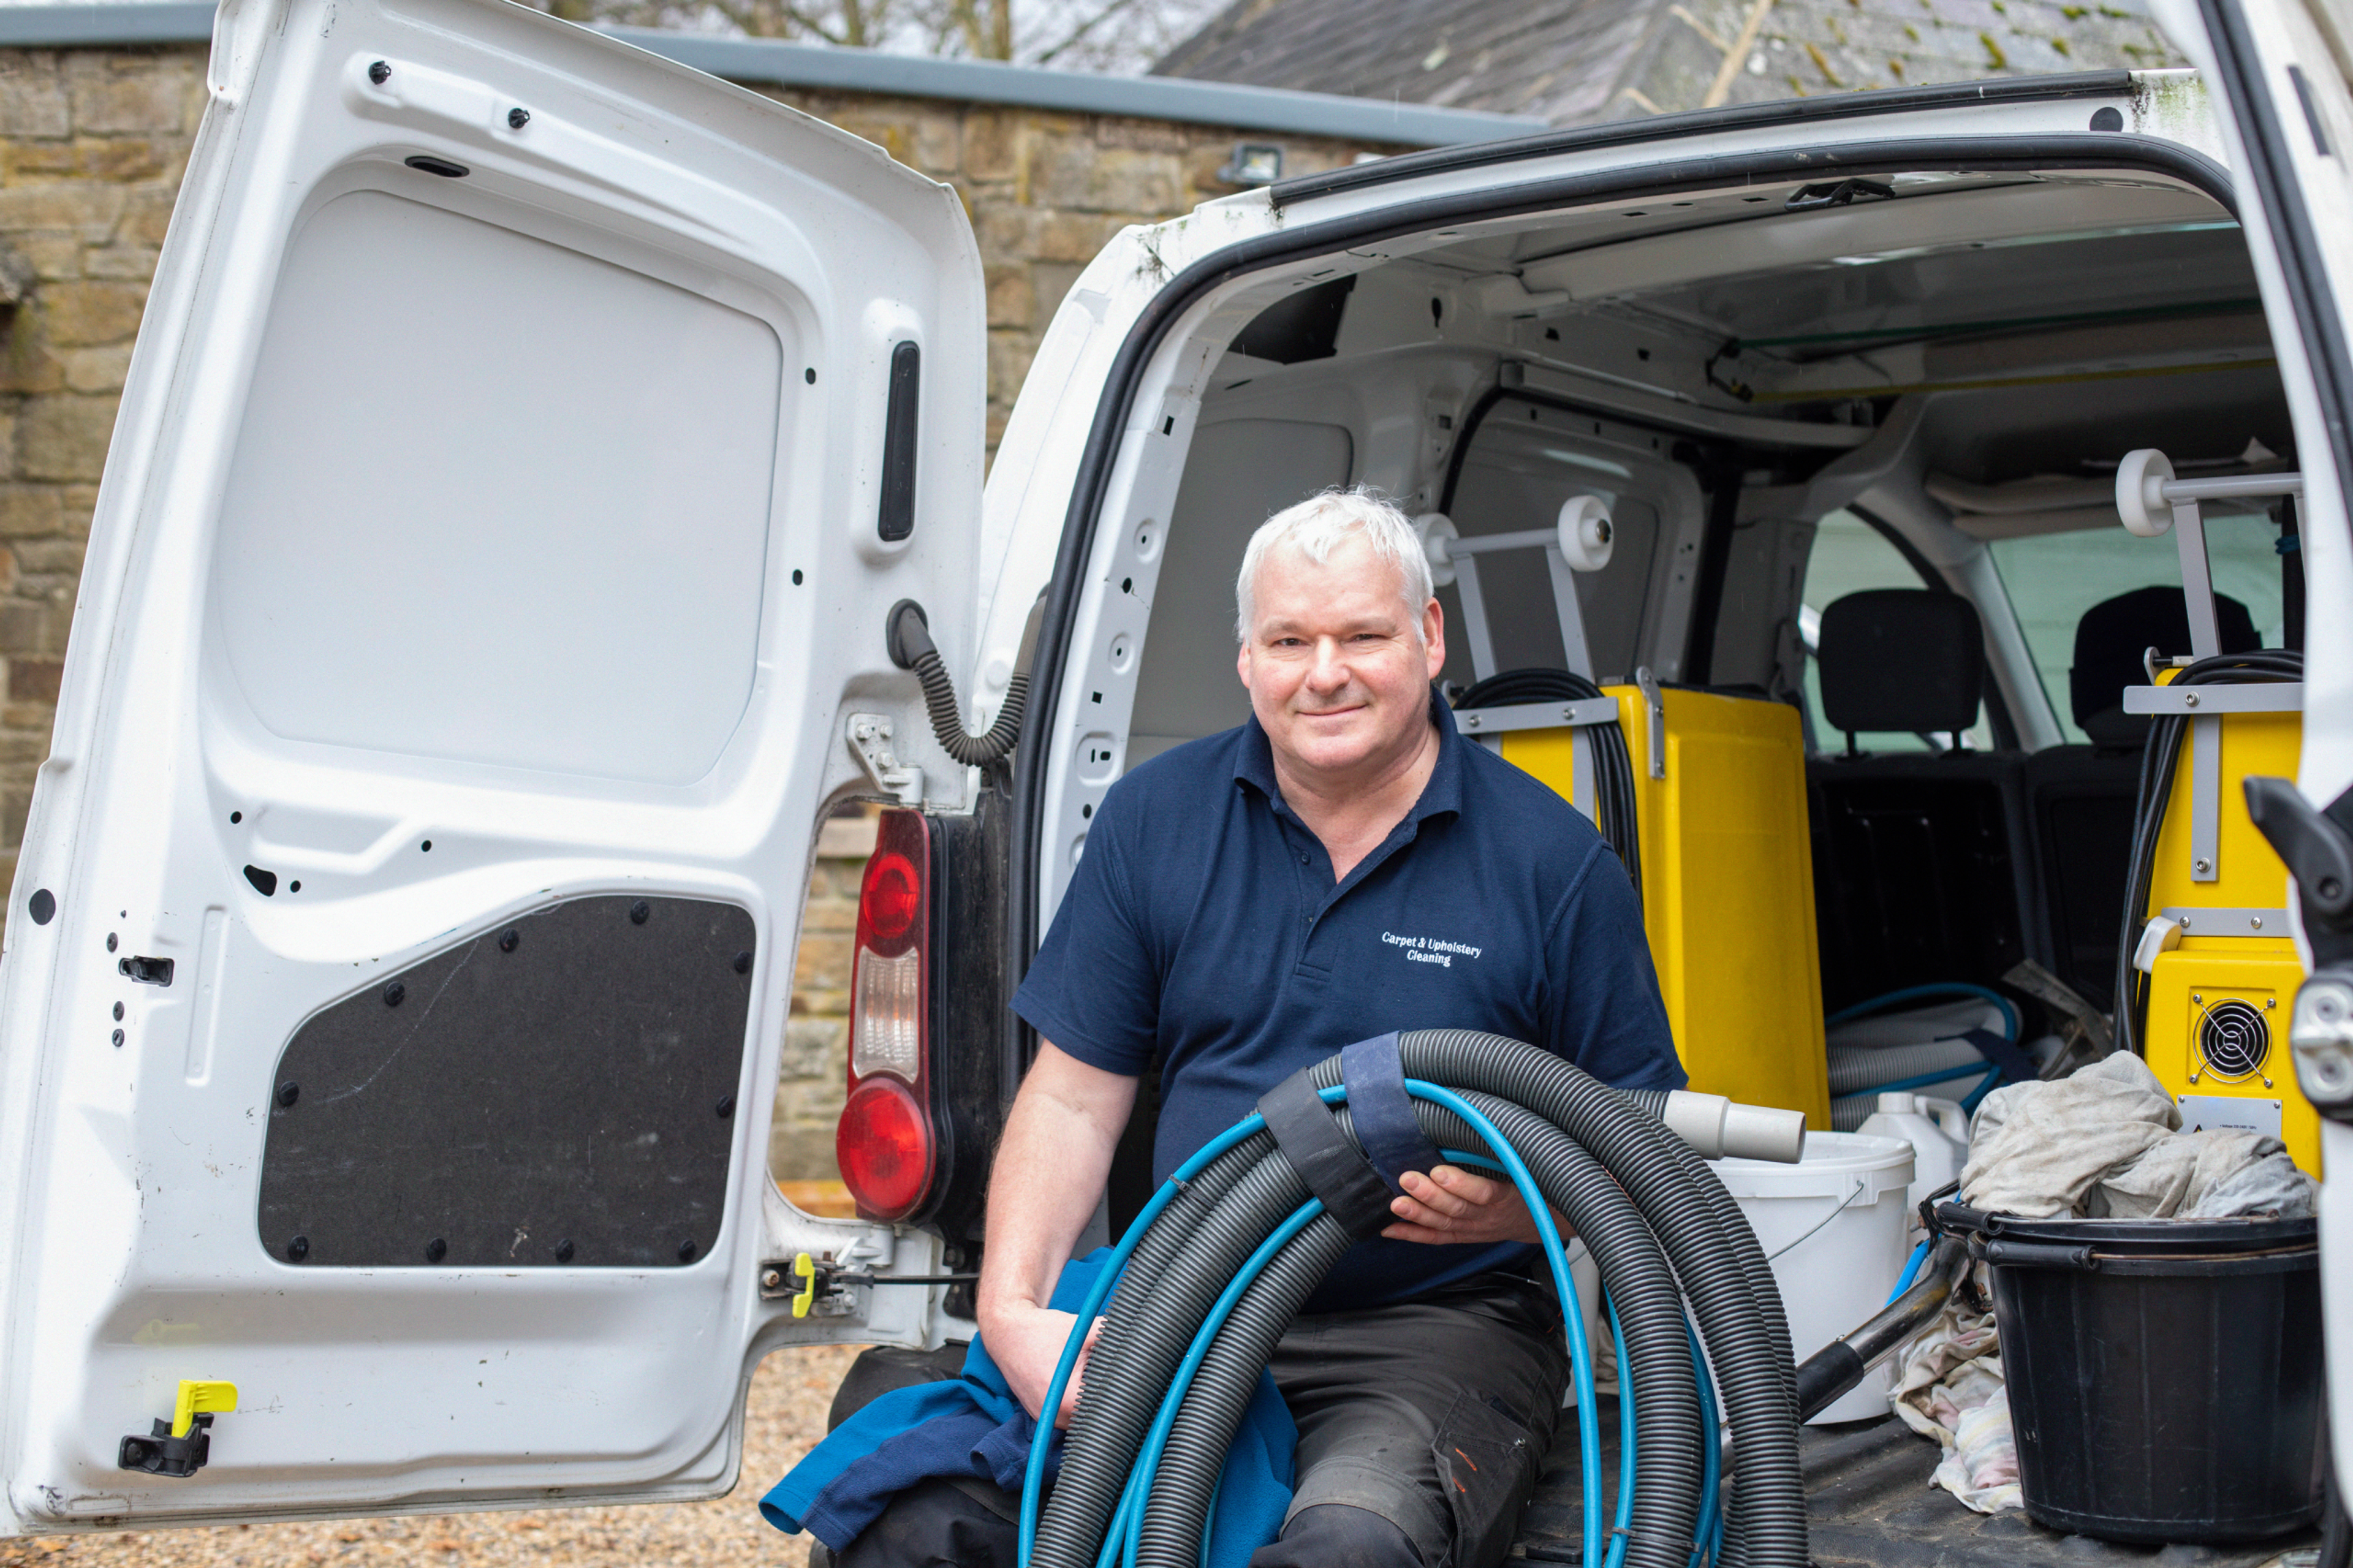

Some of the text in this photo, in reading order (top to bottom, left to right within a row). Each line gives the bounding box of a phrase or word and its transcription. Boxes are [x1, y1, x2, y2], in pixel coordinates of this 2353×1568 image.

[1382, 931, 1482, 958] Carpet & Upholstery
[1407, 950, 1451, 968] Cleaning
